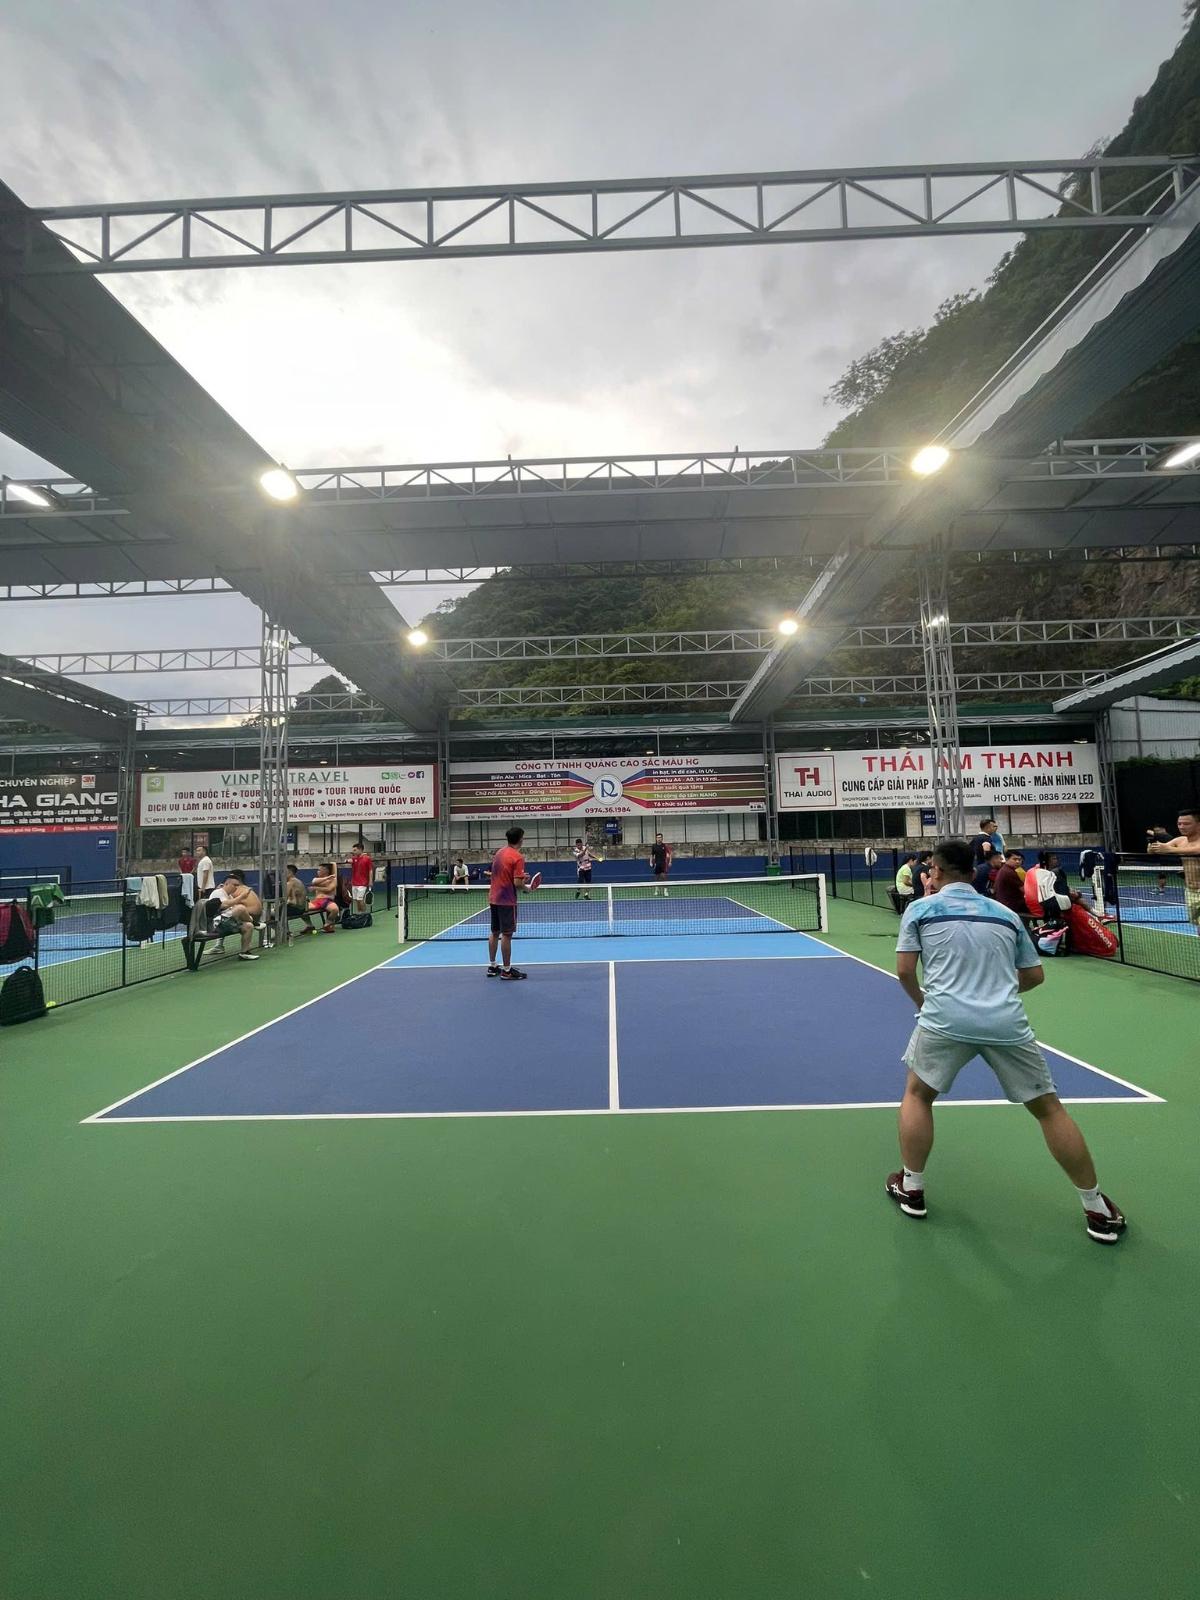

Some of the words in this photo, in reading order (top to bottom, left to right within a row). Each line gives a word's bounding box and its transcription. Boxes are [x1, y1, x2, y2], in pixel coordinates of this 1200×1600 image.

[515, 761, 541, 771] CÔNG
[544, 762, 554, 770] TY
[557, 761, 582, 770] TNHH
[585, 760, 617, 770] QUẢNG
[686, 758, 699, 766] HG
[862, 751, 924, 773] THÁI
[981, 752, 1073, 769] THANH
[0, 778, 38, 788] CHUYÊN
[289, 771, 349, 784] TRAVEL
[842, 780, 865, 792] CUNG
[868, 776, 884, 791] CẤP
[887, 776, 904, 790] GIẢI
[906, 777, 929, 790] PHÁP
[983, 774, 1001, 789] ÁNH
[1003, 774, 1026, 788] SÁNG
[1034, 773, 1054, 786] MÀN
[1056, 772, 1076, 786] HÌNH
[1078, 774, 1094, 785] LED
[36, 792, 118, 807] GIANG
[174, 791, 195, 800] TOUR
[240, 789, 261, 799] TOUR
[325, 786, 346, 796] TOUR
[349, 786, 376, 796] TRUNG
[994, 794, 1037, 802] HOTLINE:
[327, 798, 347, 807] VISA
[409, 796, 426, 805] BAY
[585, 806, 632, 814] 0974.36.1984
